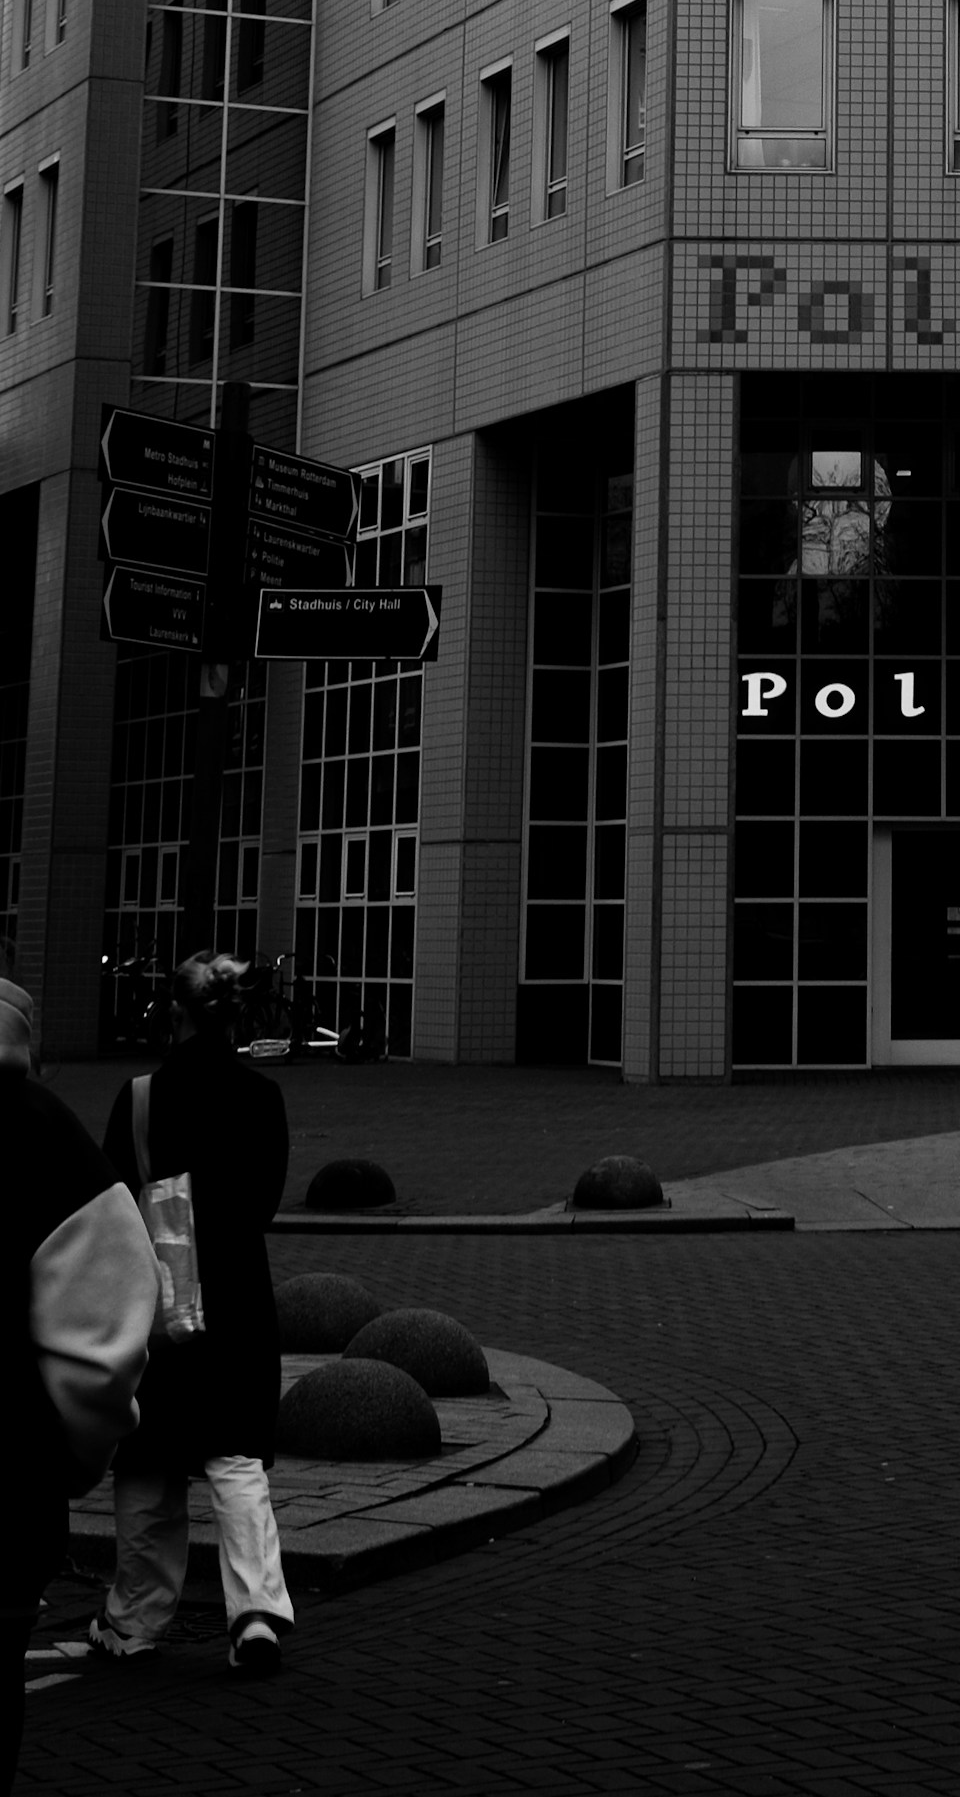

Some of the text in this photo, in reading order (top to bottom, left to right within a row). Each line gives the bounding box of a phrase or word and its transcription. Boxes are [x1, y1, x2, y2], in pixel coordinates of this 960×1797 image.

[144, 447, 198, 469] Metro Stadhuis
[168, 473, 198, 490] Hofplein
[269, 458, 336, 488] Museum Rotterdam
[267, 478, 309, 500] Timmerhuis
[265, 497, 297, 516] Markthal
[263, 532, 321, 556] Laurenskwartier
[262, 551, 284, 567] Politie
[130, 578, 153, 594] Tourist
[260, 571, 282, 586] Meent
[173, 608, 187, 620] VVV
[289, 598, 342, 610] Stadhuis
[353, 598, 376, 613] City
[379, 599, 401, 610] Hall
[150, 625, 189, 642] Laurenskerk
